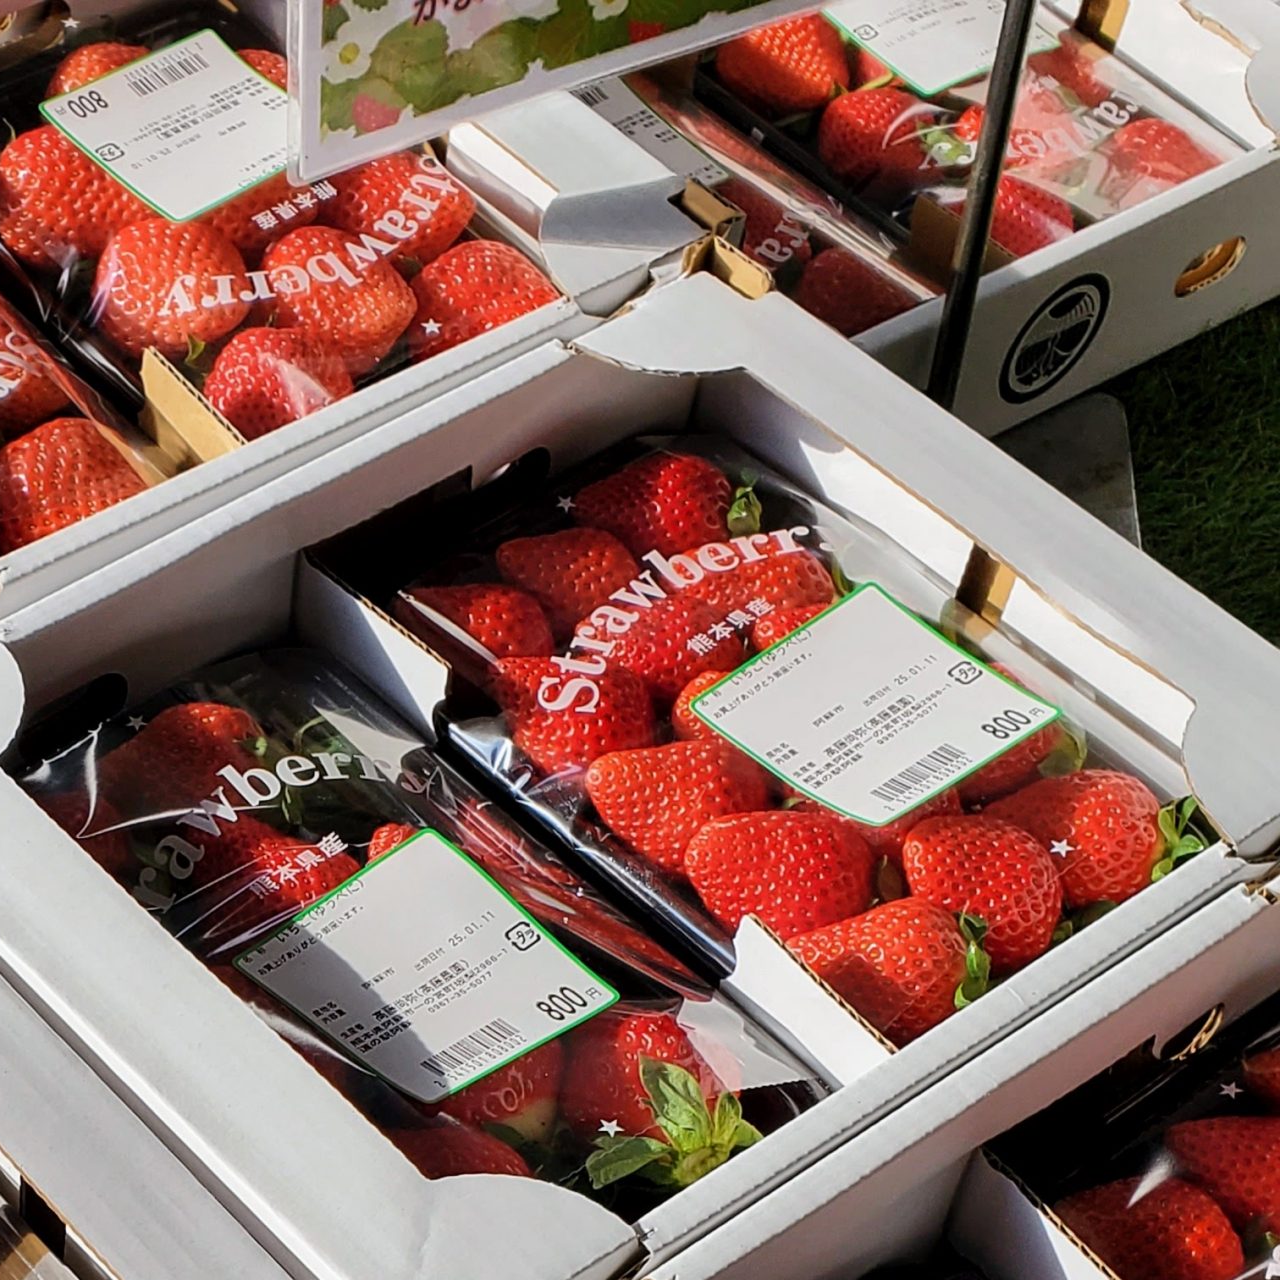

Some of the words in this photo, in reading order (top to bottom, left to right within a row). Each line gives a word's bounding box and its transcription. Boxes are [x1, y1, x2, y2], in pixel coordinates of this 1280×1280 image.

[67, 90, 109, 118] 800
[251, 180, 338, 231] 熊本県産
[537, 525, 837, 714] Strawberr
[685, 596, 775, 656] 熊本県産
[981, 710, 1031, 739] 800
[249, 831, 349, 900] 熊本県産
[536, 987, 587, 1020] 800
